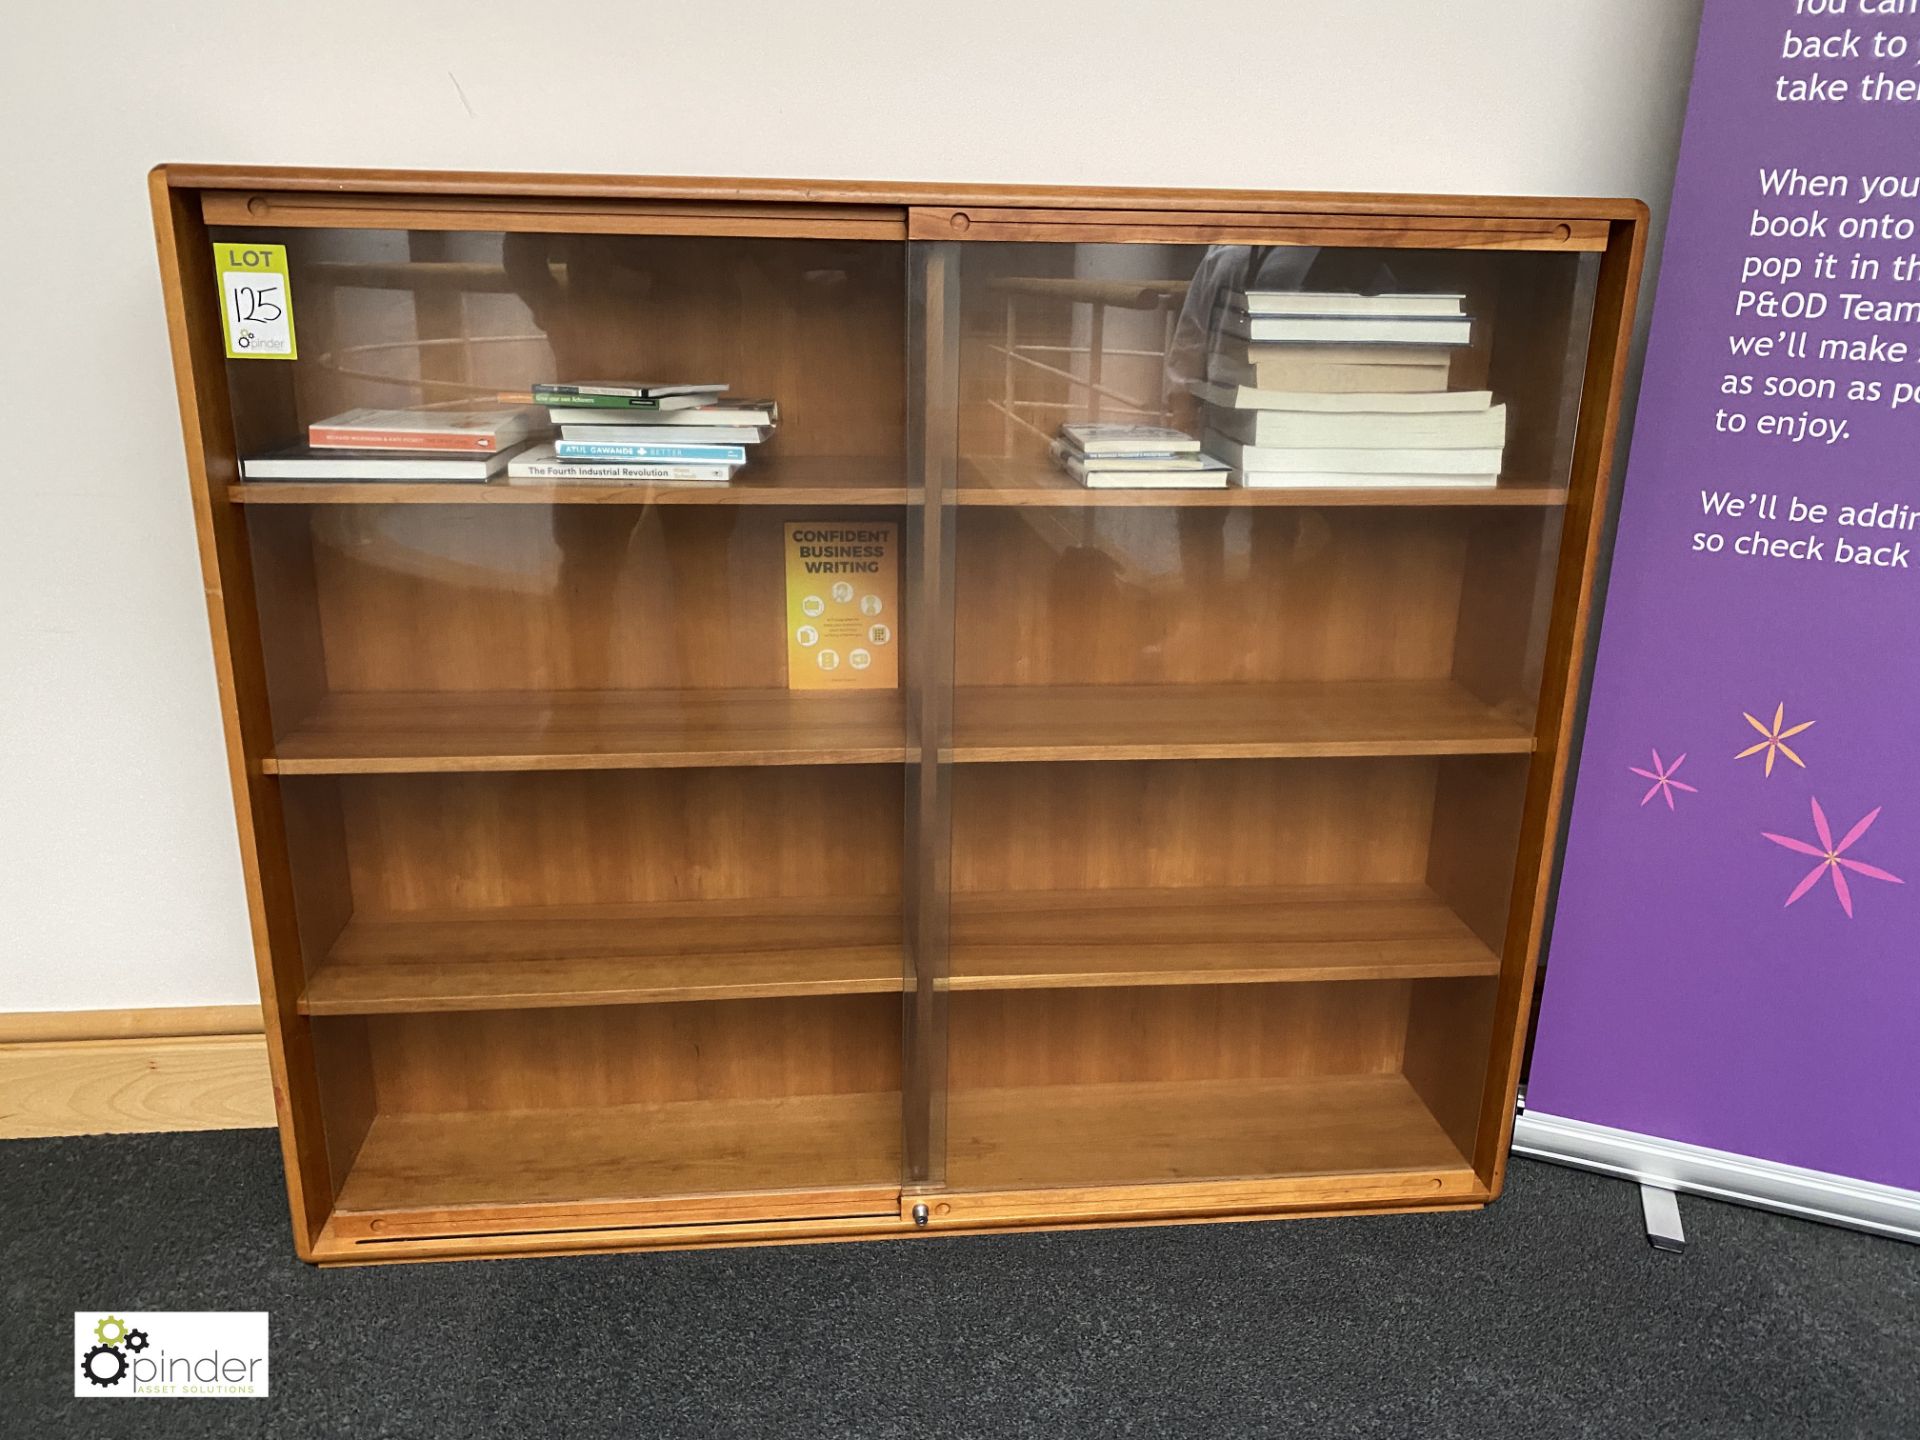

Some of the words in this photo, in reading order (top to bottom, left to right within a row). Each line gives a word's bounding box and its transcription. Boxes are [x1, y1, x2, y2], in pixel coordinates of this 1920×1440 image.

[1859, 0, 1917, 14] can
[1782, 29, 1861, 58] back
[1873, 31, 1908, 58] to
[1776, 72, 1848, 101] take
[1861, 72, 1920, 101] the
[1759, 168, 1848, 196] When
[1858, 175, 1920, 204] you
[1750, 209, 1829, 238] book
[1839, 214, 1915, 240] onto
[229, 250, 273, 267] LOT
[1741, 256, 1802, 284] pop
[1814, 252, 1838, 279] it
[1850, 252, 1879, 280] in
[234, 287, 282, 323] 125
[1736, 290, 1828, 319] P&OD
[1839, 293, 1920, 322] Team
[250, 337, 284, 351] pinder
[1729, 331, 1807, 358] we’ll
[1819, 335, 1908, 362] make
[1721, 374, 1753, 394] as
[1764, 376, 1836, 399] soon
[1847, 380, 1882, 401] as
[1715, 409, 1746, 432] to
[1756, 411, 1850, 444] enjoy.
[565, 445, 587, 454] ATUL
[590, 446, 633, 455] GAWANDE
[528, 466, 546, 475] The
[548, 467, 576, 476] Fourth
[579, 467, 620, 477] Industrial
[622, 468, 669, 478] Revolution
[1701, 490, 1777, 520] We’ll
[1788, 496, 1828, 523] be
[792, 530, 890, 543] CONFIDENT
[1692, 532, 1724, 552] so
[1734, 531, 1825, 560] check
[1834, 538, 1911, 568] back
[800, 546, 884, 558] BUSINESS
[805, 561, 879, 573] WRITING
